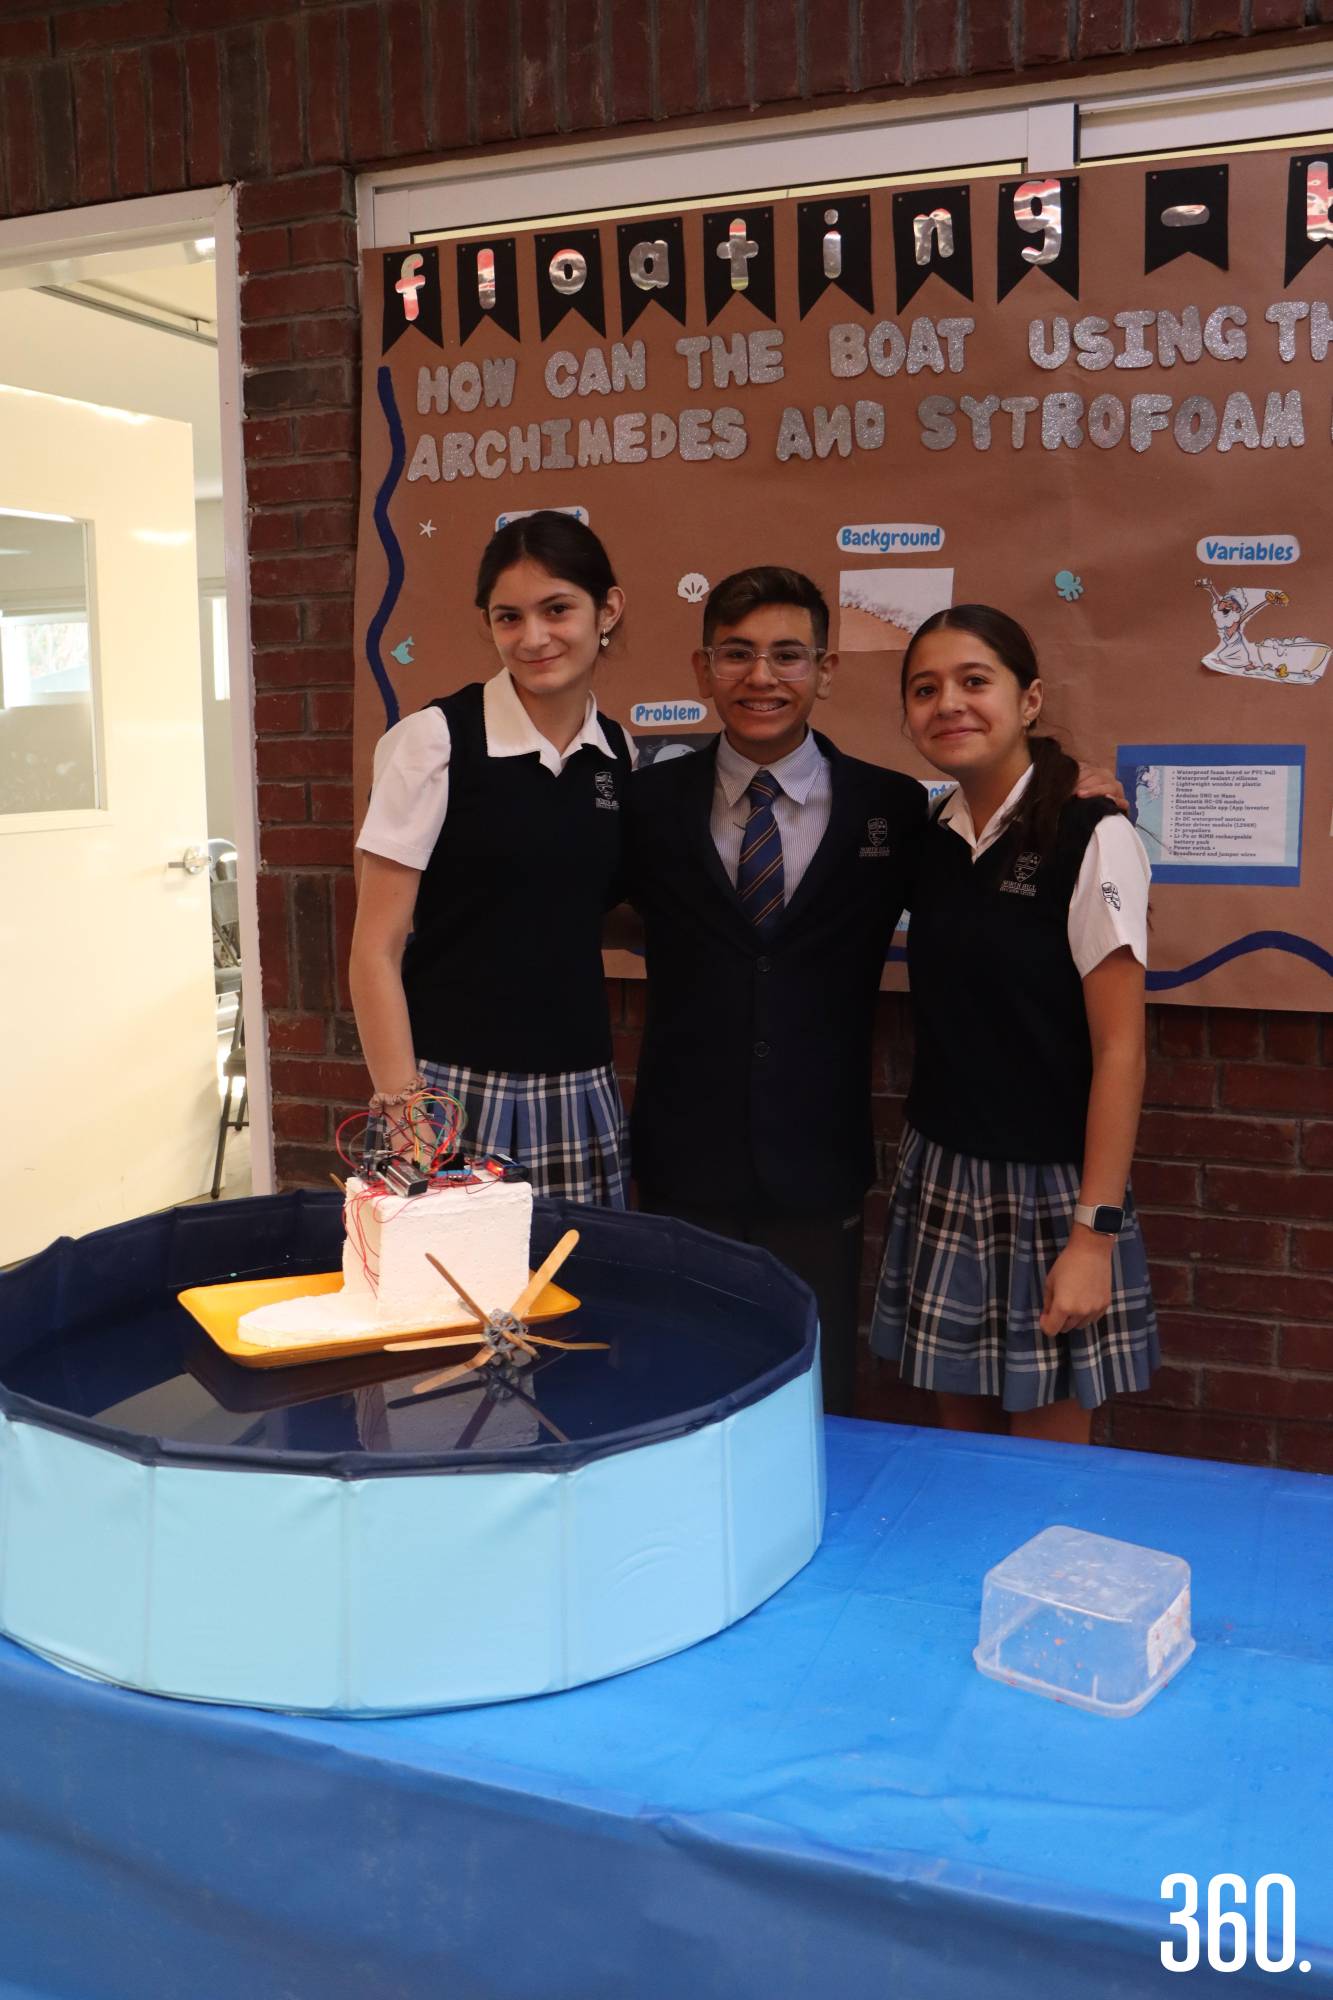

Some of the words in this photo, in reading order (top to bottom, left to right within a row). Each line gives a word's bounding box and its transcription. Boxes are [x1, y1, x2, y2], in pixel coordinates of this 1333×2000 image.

[417, 358, 516, 415] HOW
[544, 340, 646, 399] CAN
[675, 329, 785, 390] THE
[828, 317, 975, 378] BOAT
[1028, 305, 1248, 371] USING
[406, 407, 748, 482] ARCHIMEDES
[776, 400, 885, 462] AND
[918, 390, 1305, 454] SYTROFOAM
[841, 528, 941, 552] Background
[1206, 541, 1294, 561] Variables
[636, 704, 700, 722] Problem
